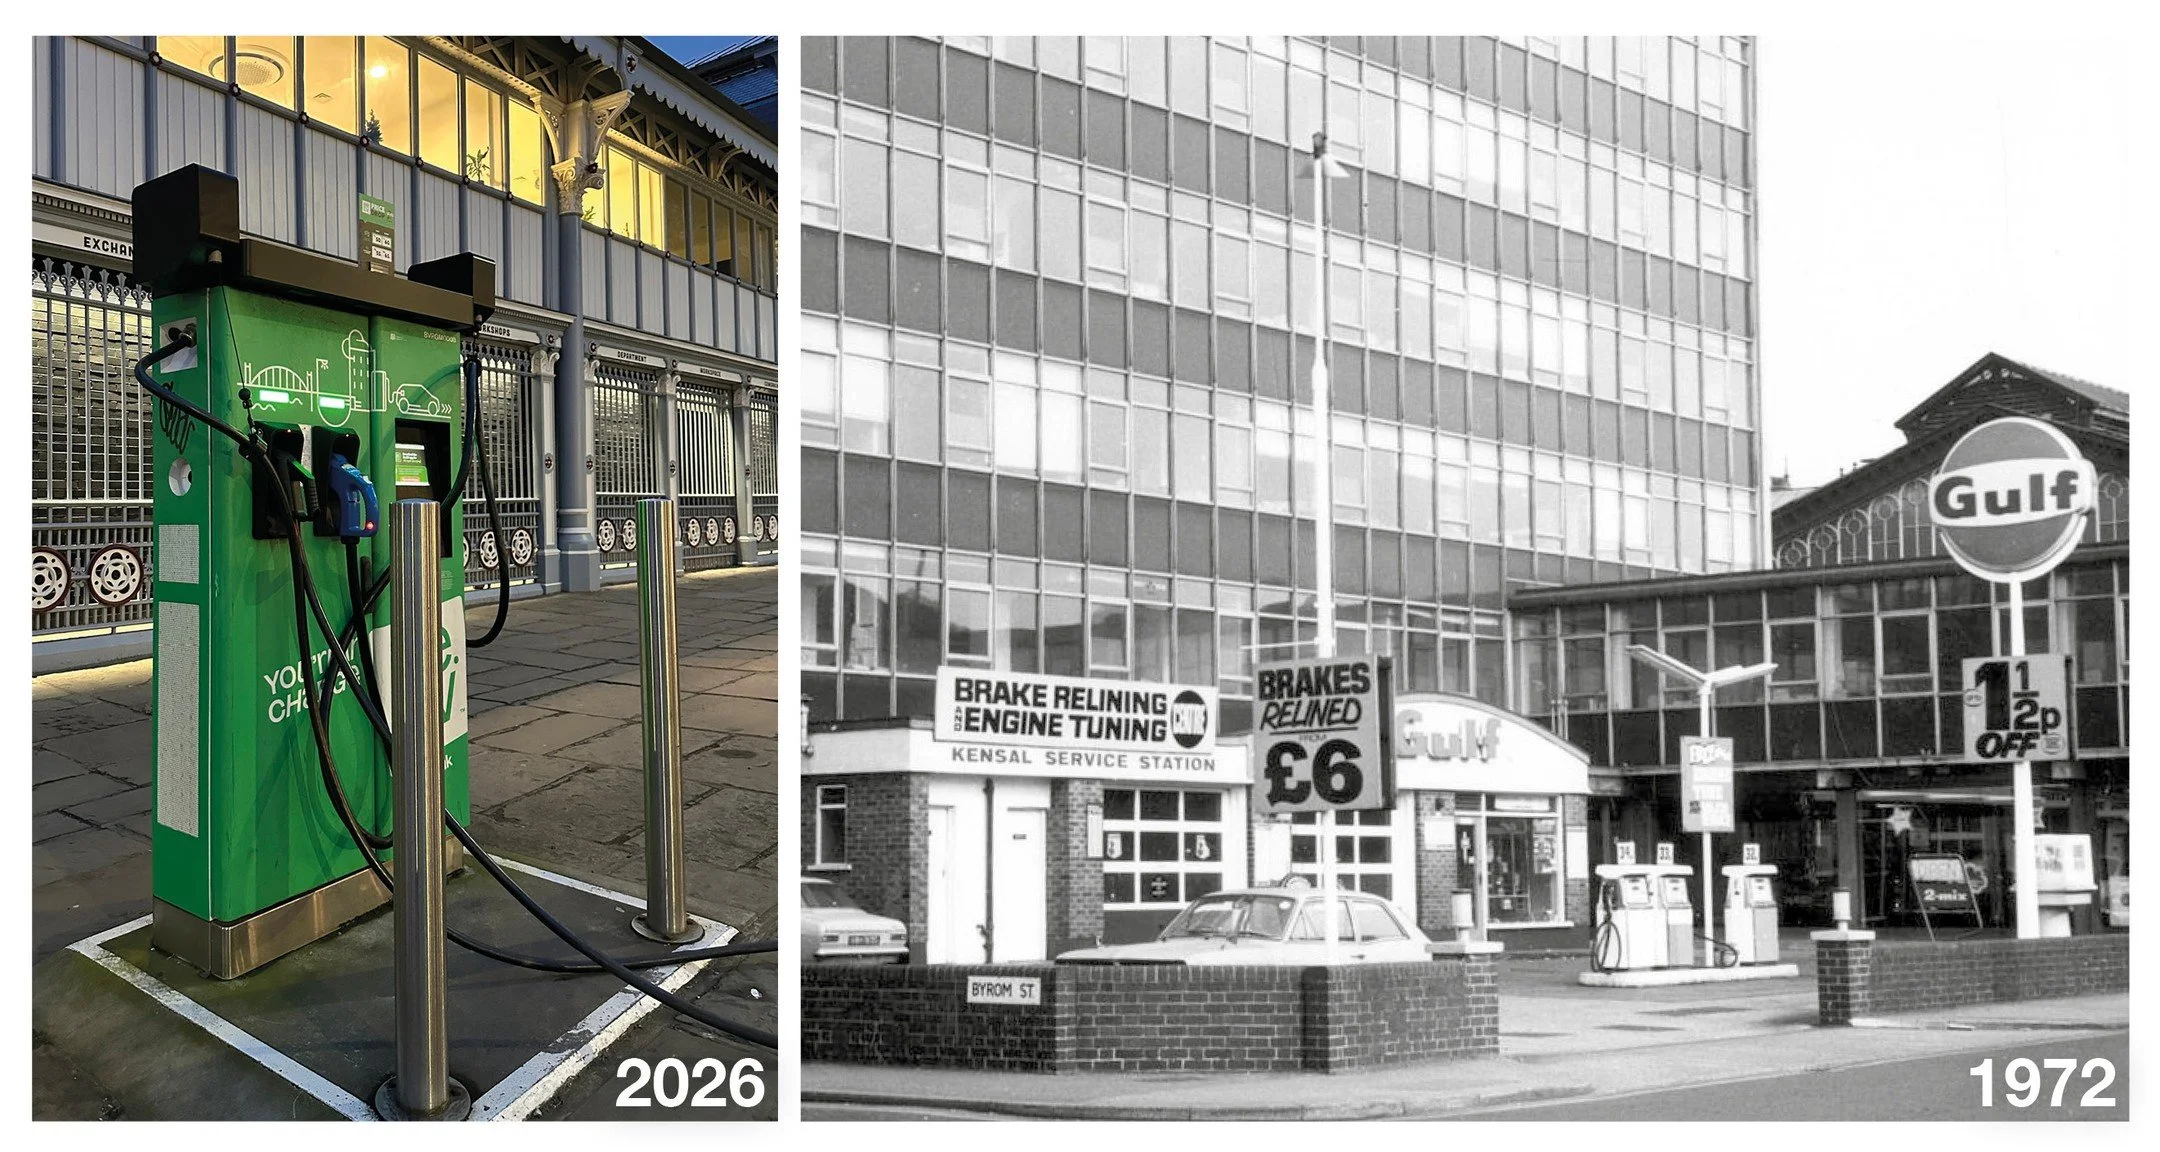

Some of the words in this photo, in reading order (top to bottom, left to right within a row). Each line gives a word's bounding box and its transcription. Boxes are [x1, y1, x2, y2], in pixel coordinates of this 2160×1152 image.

[1935, 469, 2080, 520] Gulf
[955, 677, 1048, 708] BRAKE
[1054, 685, 1168, 715] RELINING
[1258, 662, 1371, 700] BRAKES
[954, 706, 962, 732] AND
[964, 707, 1064, 737] ENGINE
[1068, 714, 1168, 742] TUNING
[1260, 698, 1363, 731] RELINED
[1299, 733, 1328, 743] FROM
[1395, 709, 1502, 763] Gulf
[1975, 731, 2041, 759] OFF
[952, 746, 1033, 764] KENSAL
[1045, 751, 1129, 769] SERVICE
[1139, 755, 1216, 772] STATION
[1264, 738, 1364, 808] £6
[972, 981, 1013, 998] BYROM
[1020, 982, 1035, 998] ST
